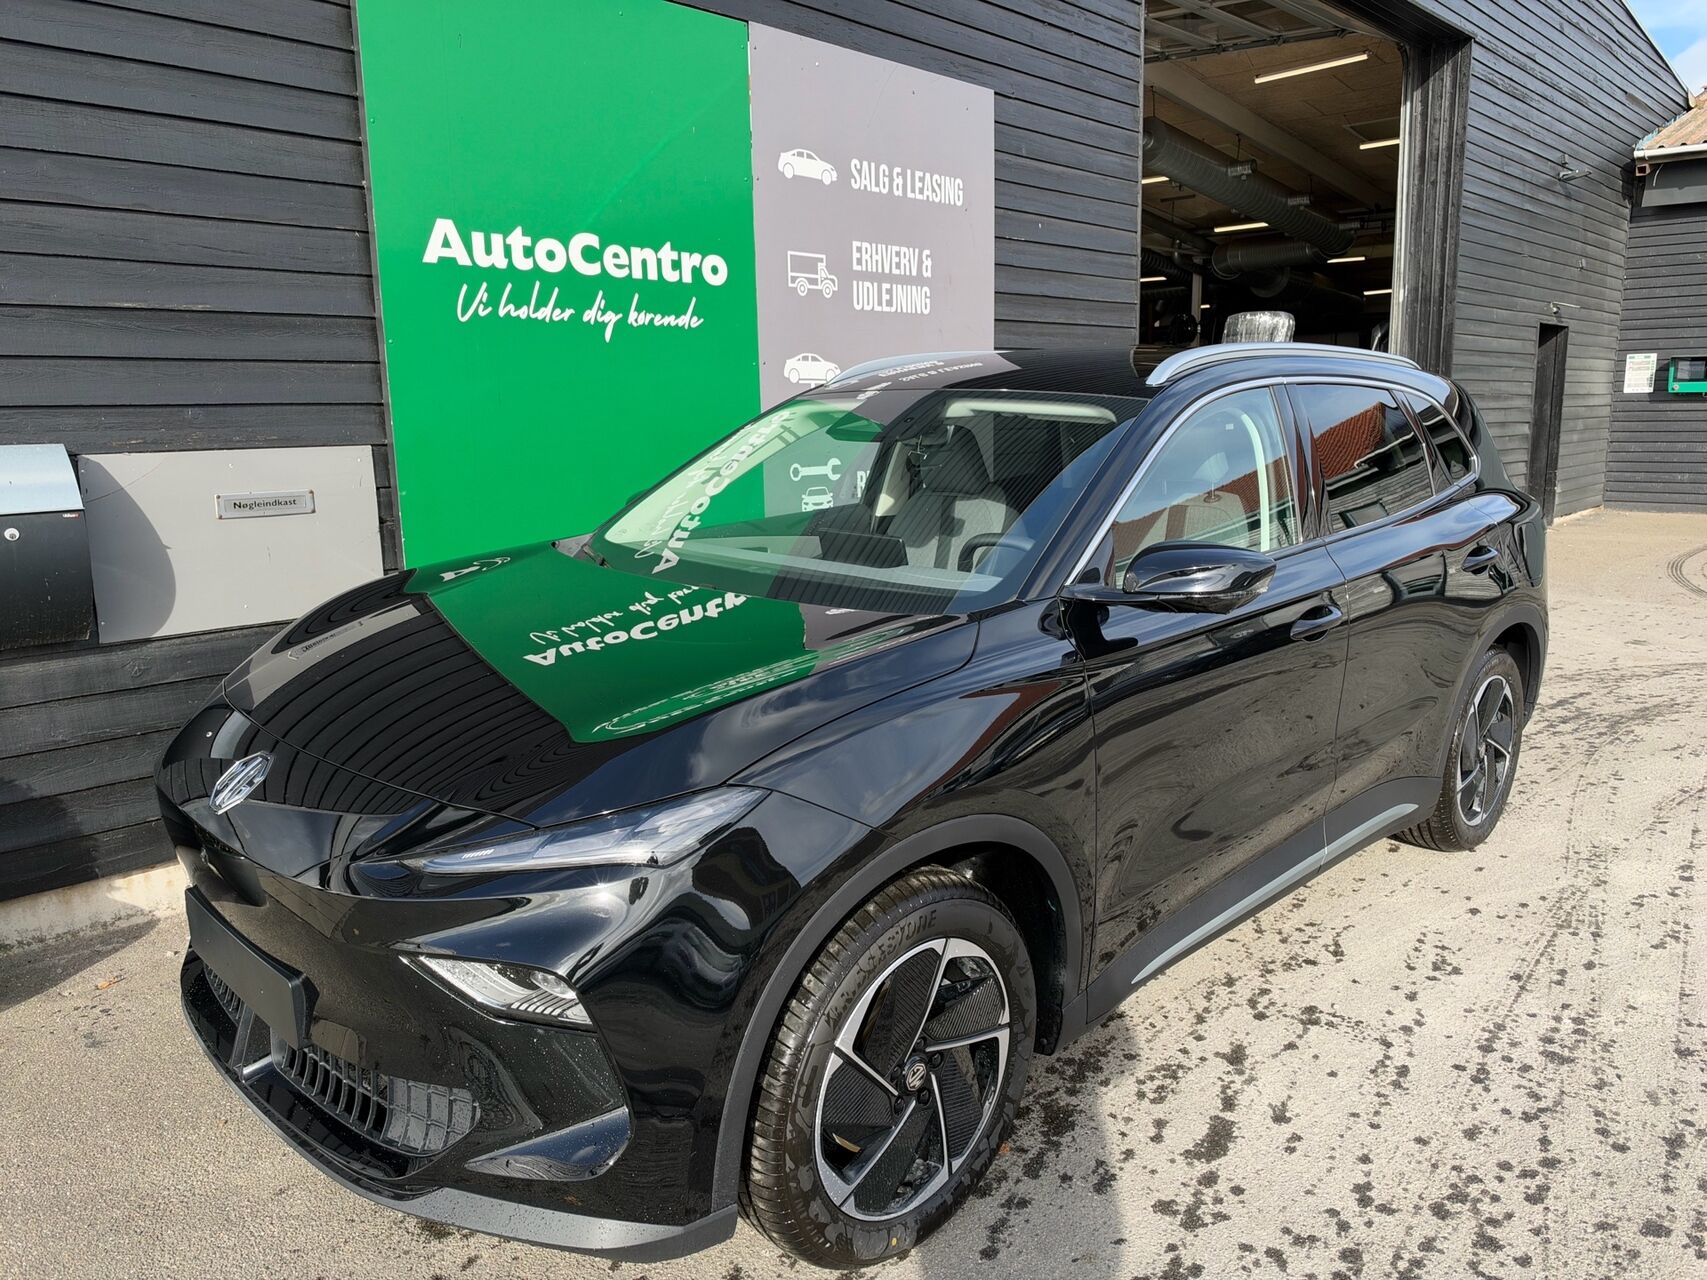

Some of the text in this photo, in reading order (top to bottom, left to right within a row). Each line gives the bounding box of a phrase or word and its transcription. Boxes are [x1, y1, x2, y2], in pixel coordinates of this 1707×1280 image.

[850, 158, 964, 207] SALG & LEASING
[422, 217, 728, 286] AutoCentro
[852, 240, 933, 278] ERHVERV &
[457, 281, 492, 323] Vi
[498, 280, 576, 323] holder
[582, 289, 623, 343] dig
[852, 279, 931, 315] UDLEJNING
[233, 499, 297, 511] Nøgleindkast
